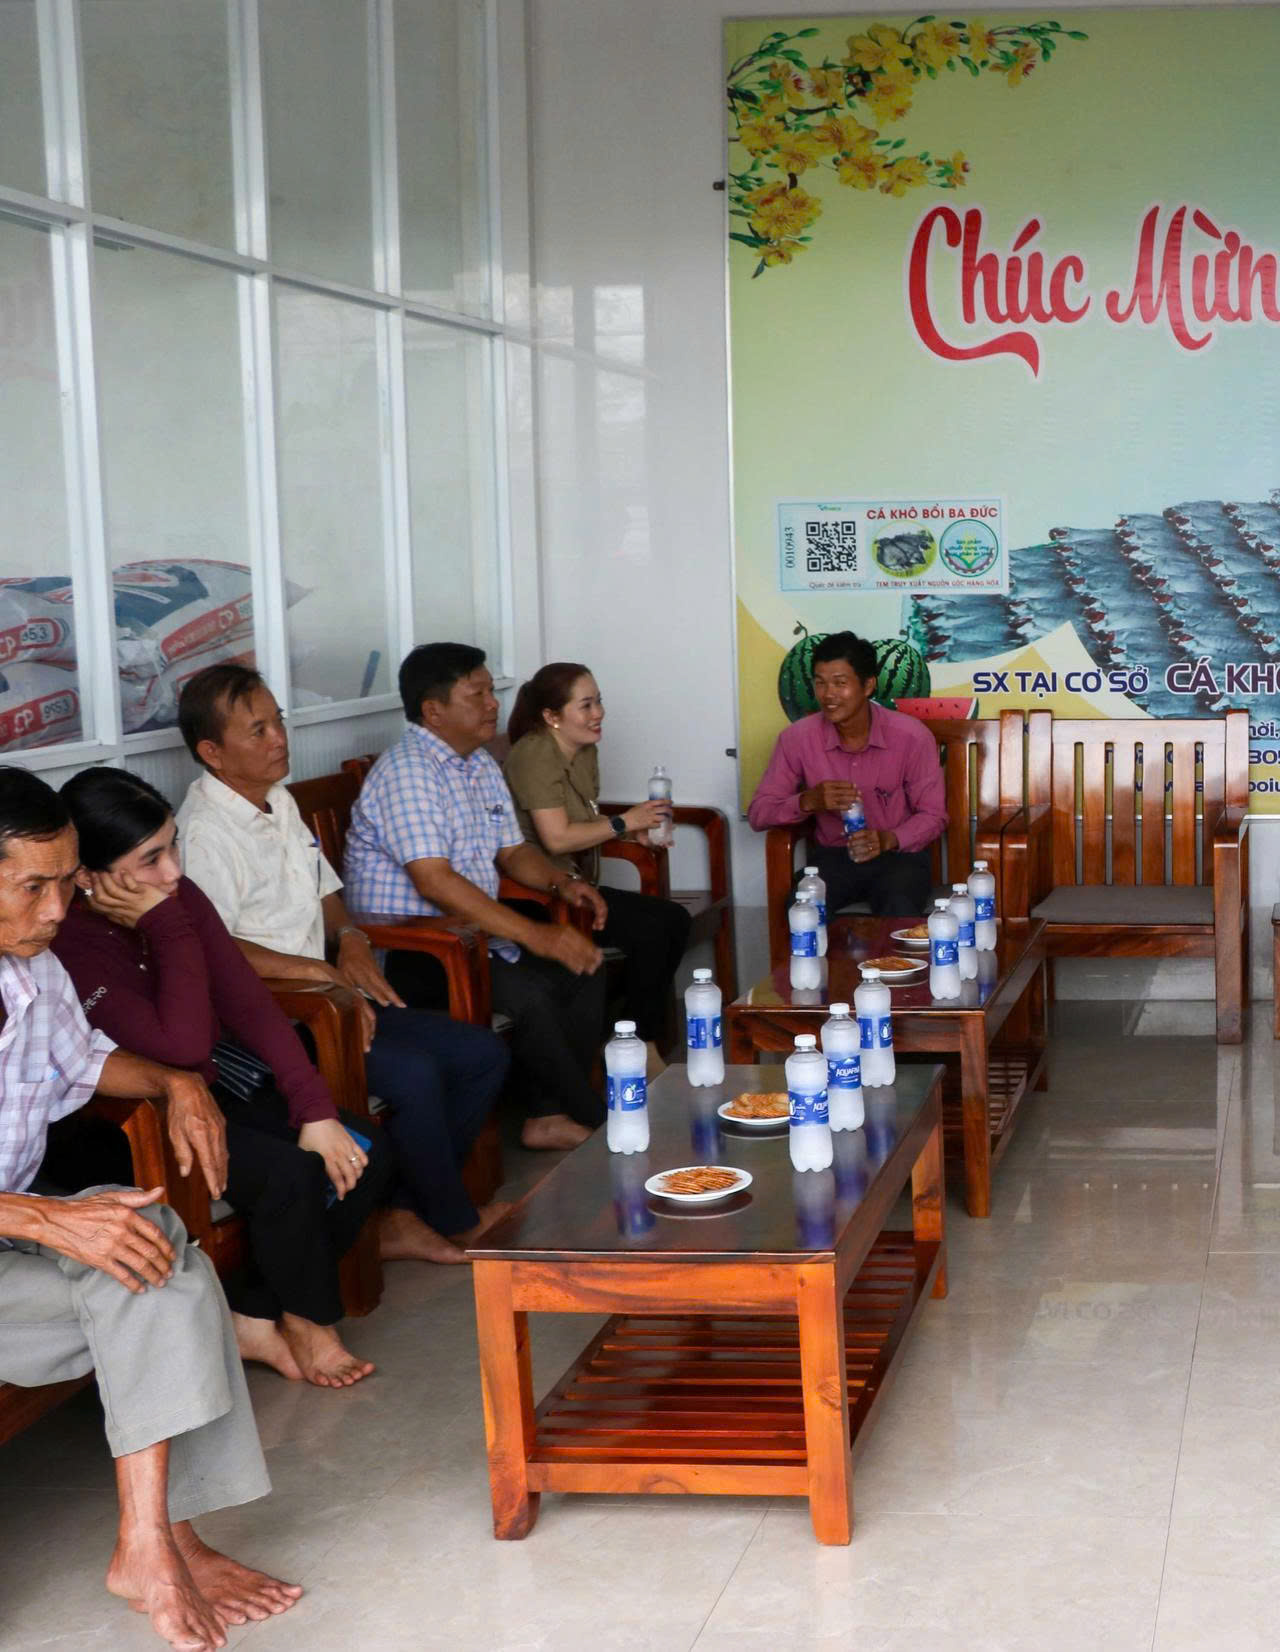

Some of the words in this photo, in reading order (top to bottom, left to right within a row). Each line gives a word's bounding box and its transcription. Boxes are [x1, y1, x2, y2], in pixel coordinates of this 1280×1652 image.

[908, 204, 1091, 379] Chúc
[867, 507, 886, 519] CÁ
[890, 506, 918, 519] KHÔ
[949, 508, 965, 518] BA
[970, 504, 998, 518] ĐỨC
[973, 671, 1010, 692] SX
[1015, 671, 1057, 698] TẠI
[1065, 668, 1102, 692] CƠ
[1108, 666, 1148, 692] SỞ
[1167, 656, 1219, 694] CÁ
